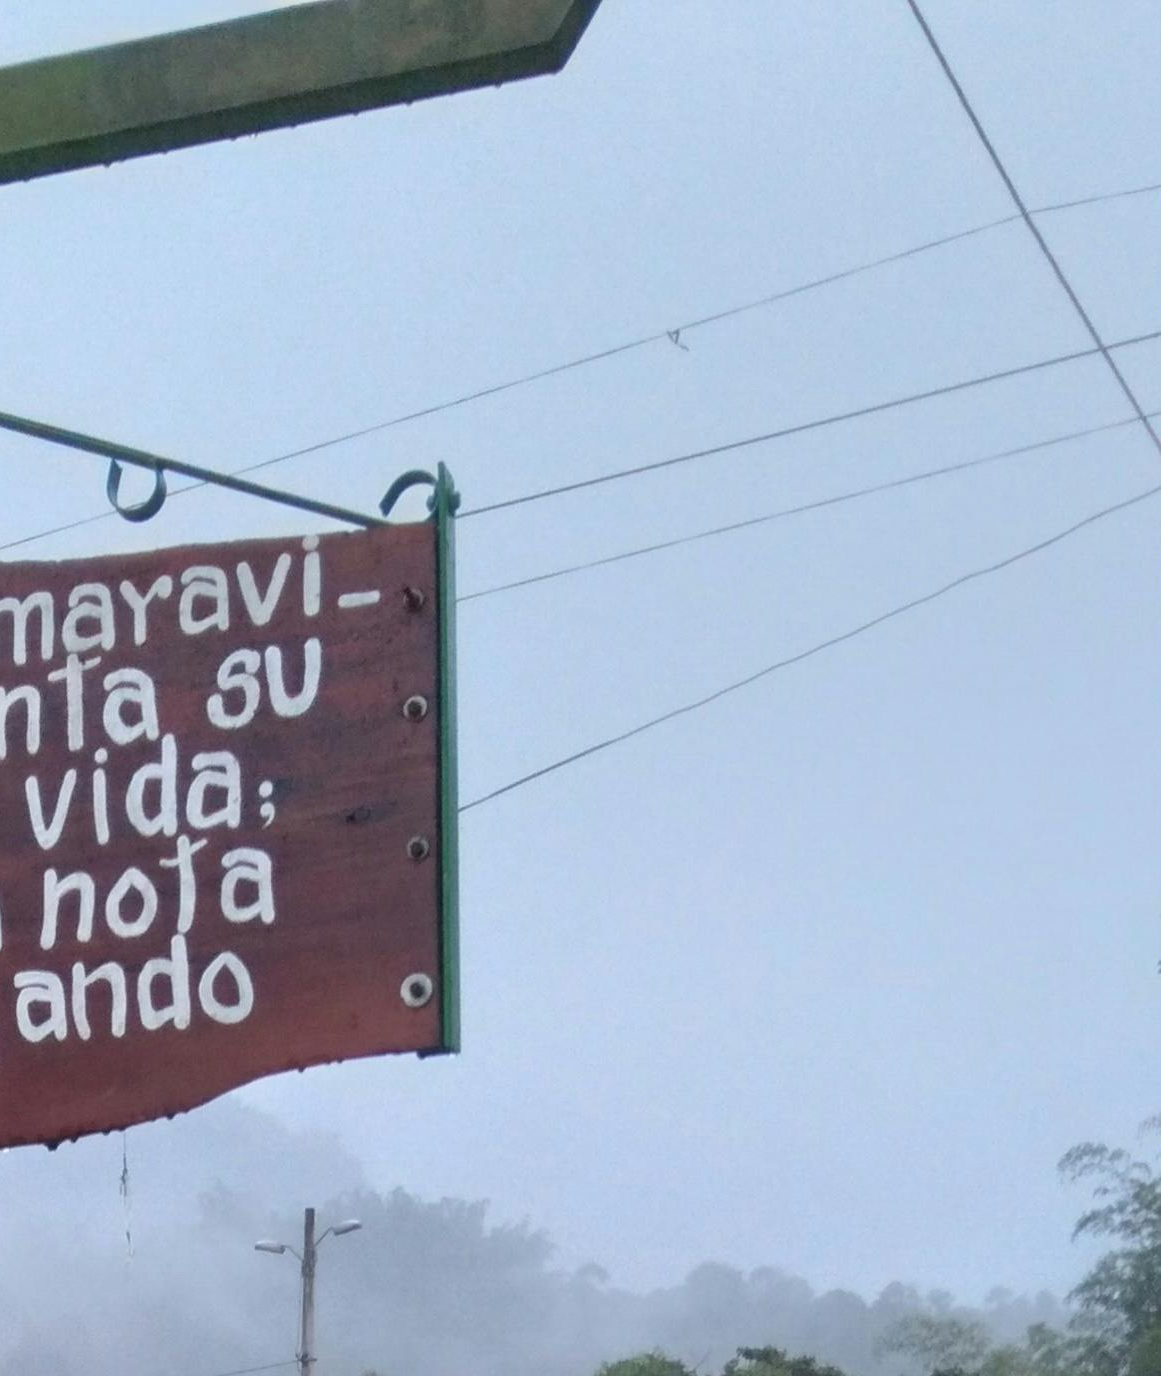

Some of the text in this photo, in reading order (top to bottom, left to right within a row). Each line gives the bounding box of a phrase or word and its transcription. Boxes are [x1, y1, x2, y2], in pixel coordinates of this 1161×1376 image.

[207, 638, 322, 729] su
[25, 733, 275, 850] vida;
[40, 836, 275, 950] nota
